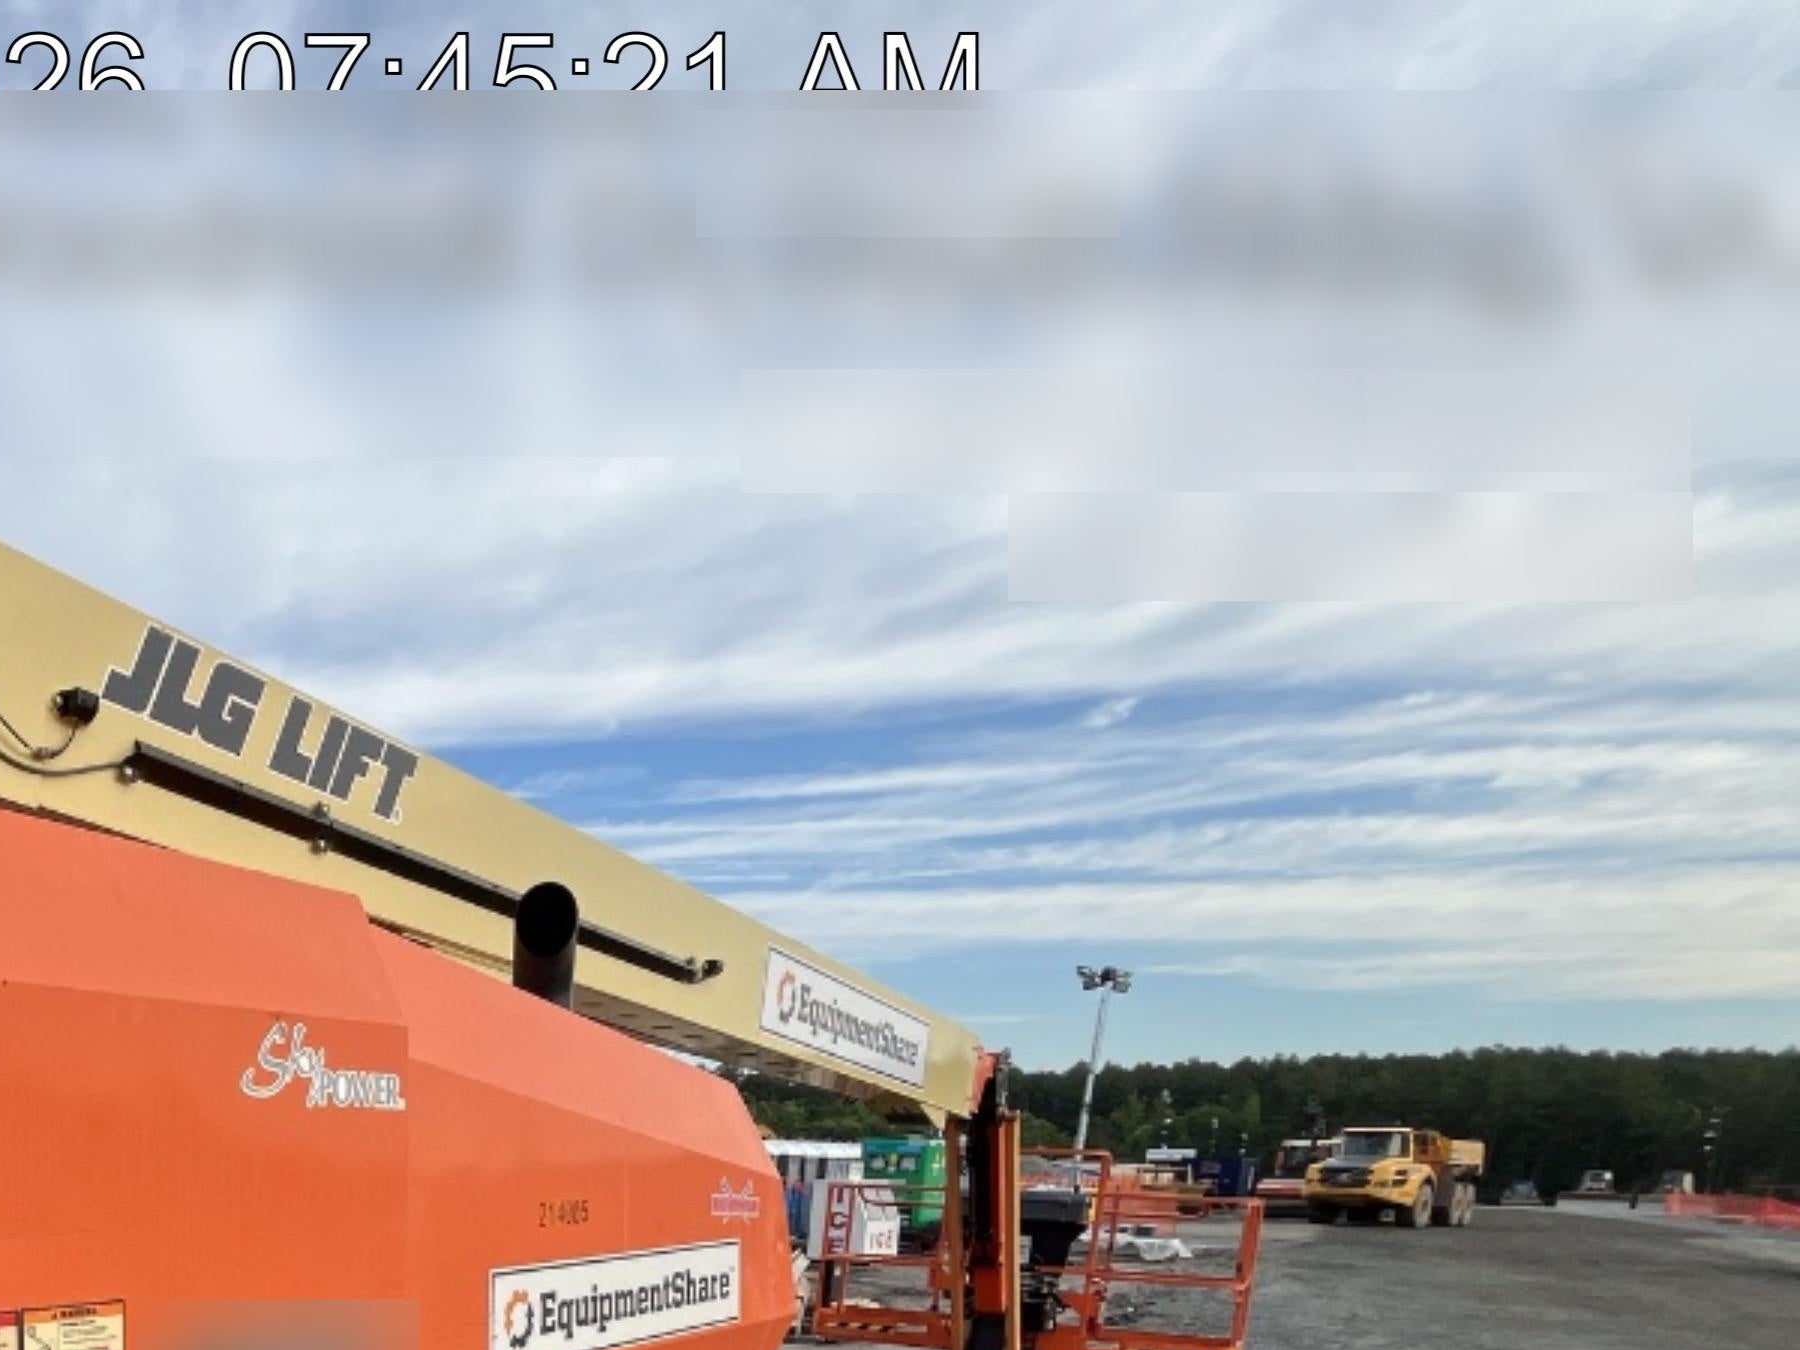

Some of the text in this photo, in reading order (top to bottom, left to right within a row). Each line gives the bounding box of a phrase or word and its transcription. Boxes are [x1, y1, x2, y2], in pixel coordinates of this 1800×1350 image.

[99, 621, 419, 823] JLG LIFT
[797, 983, 919, 1066] EquipmentShare
[318, 1069, 400, 1109] POWER
[539, 1268, 730, 1340] EquipmentShare
